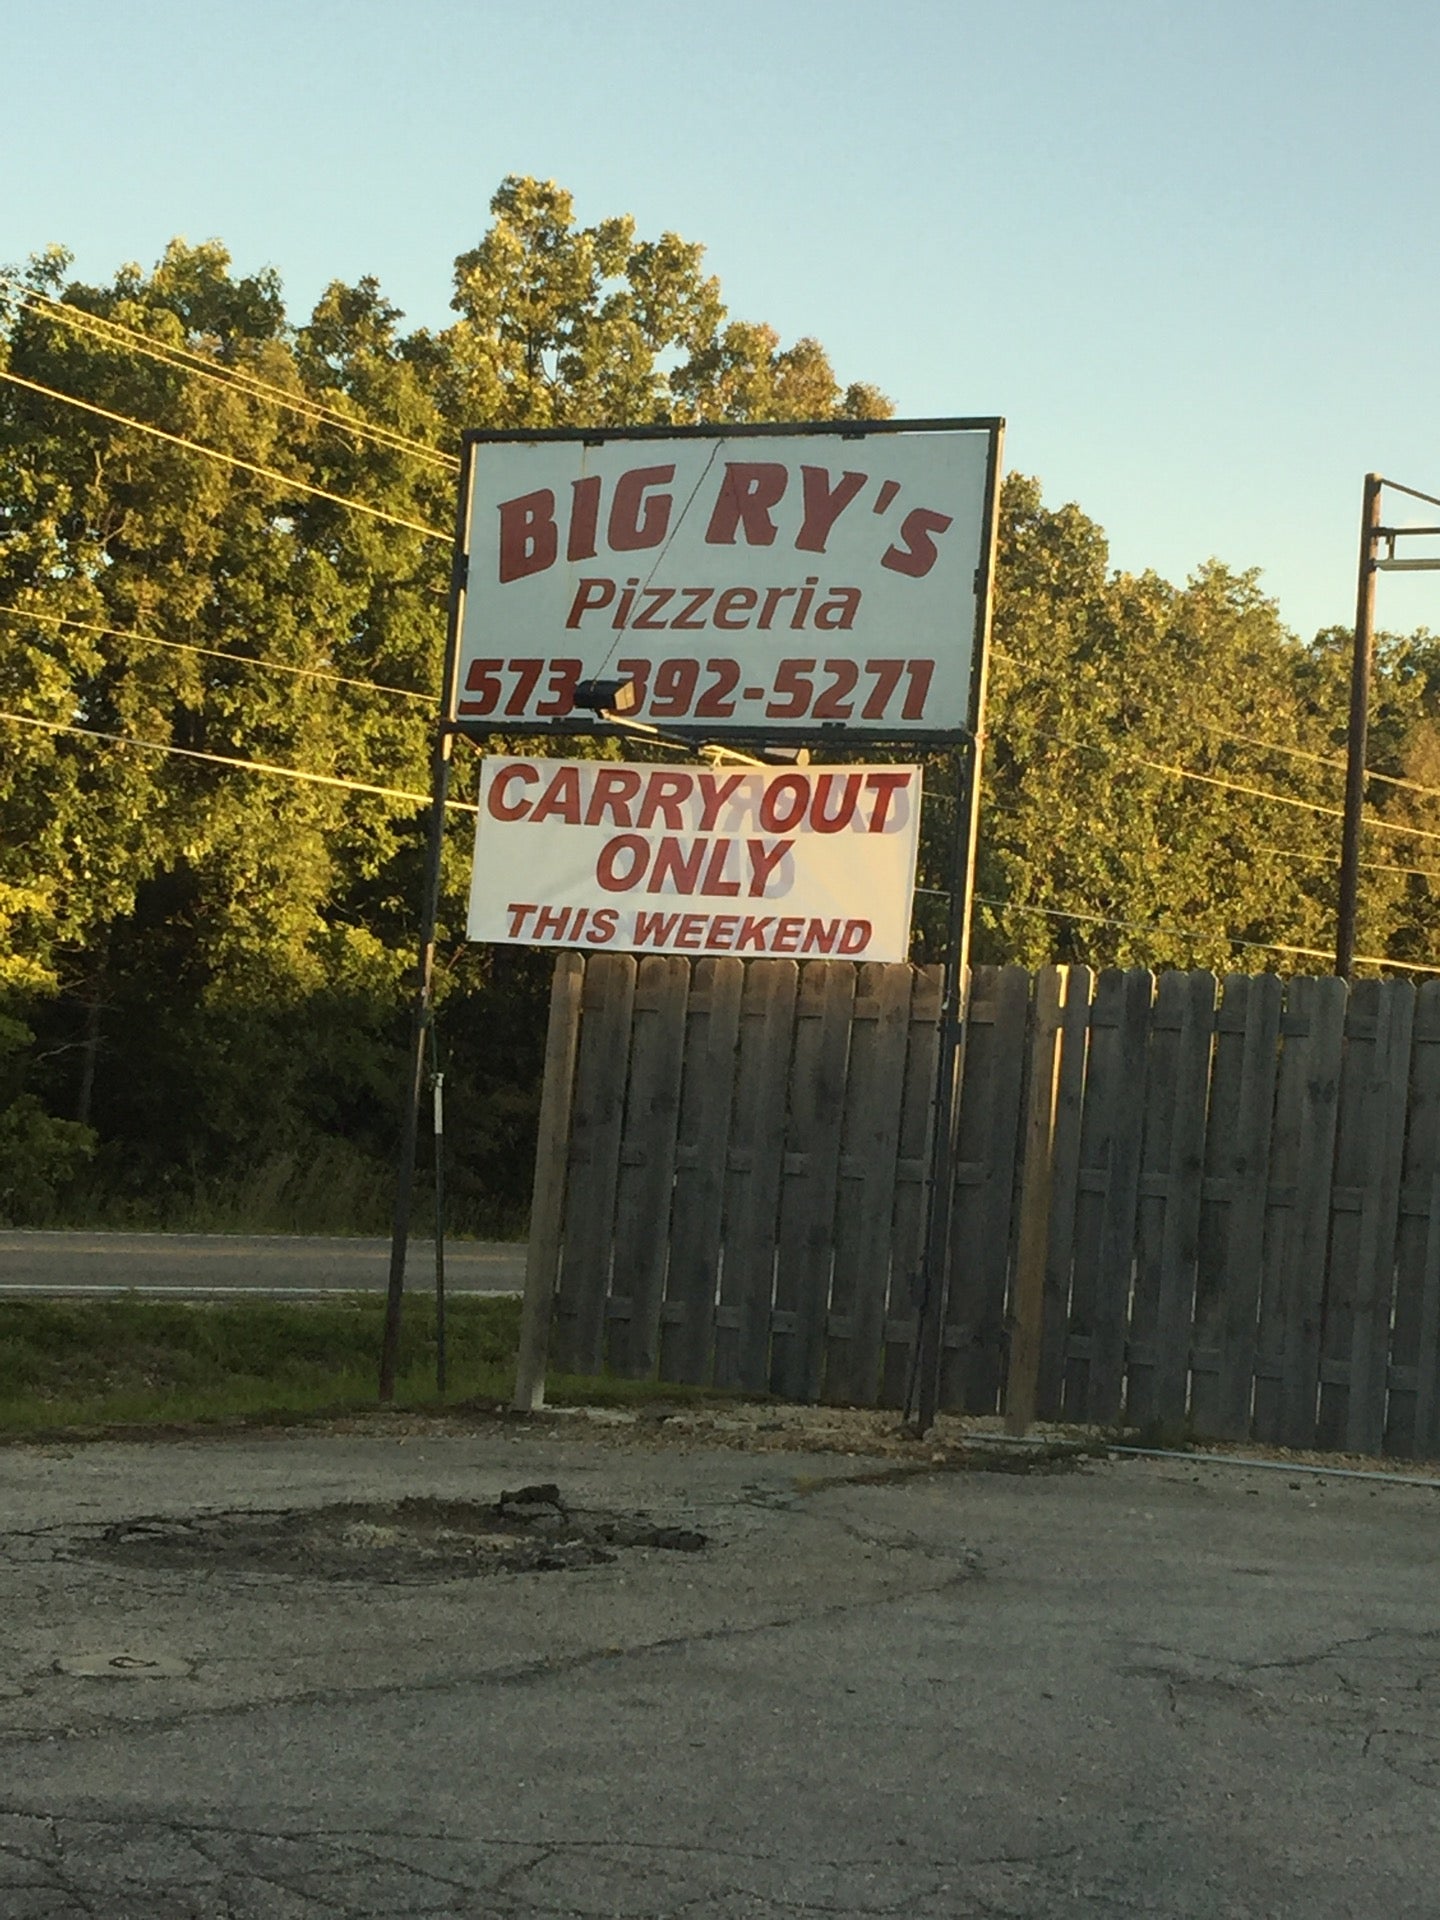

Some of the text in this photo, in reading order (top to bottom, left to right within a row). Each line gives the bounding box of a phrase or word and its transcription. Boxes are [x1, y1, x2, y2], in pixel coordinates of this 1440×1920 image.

[497, 464, 676, 584] BIG
[565, 577, 862, 631] Pizzeria
[486, 763, 912, 835] CARRY OUT
[596, 833, 796, 898] ONLY
[506, 903, 873, 956] THIS WEEKEND
